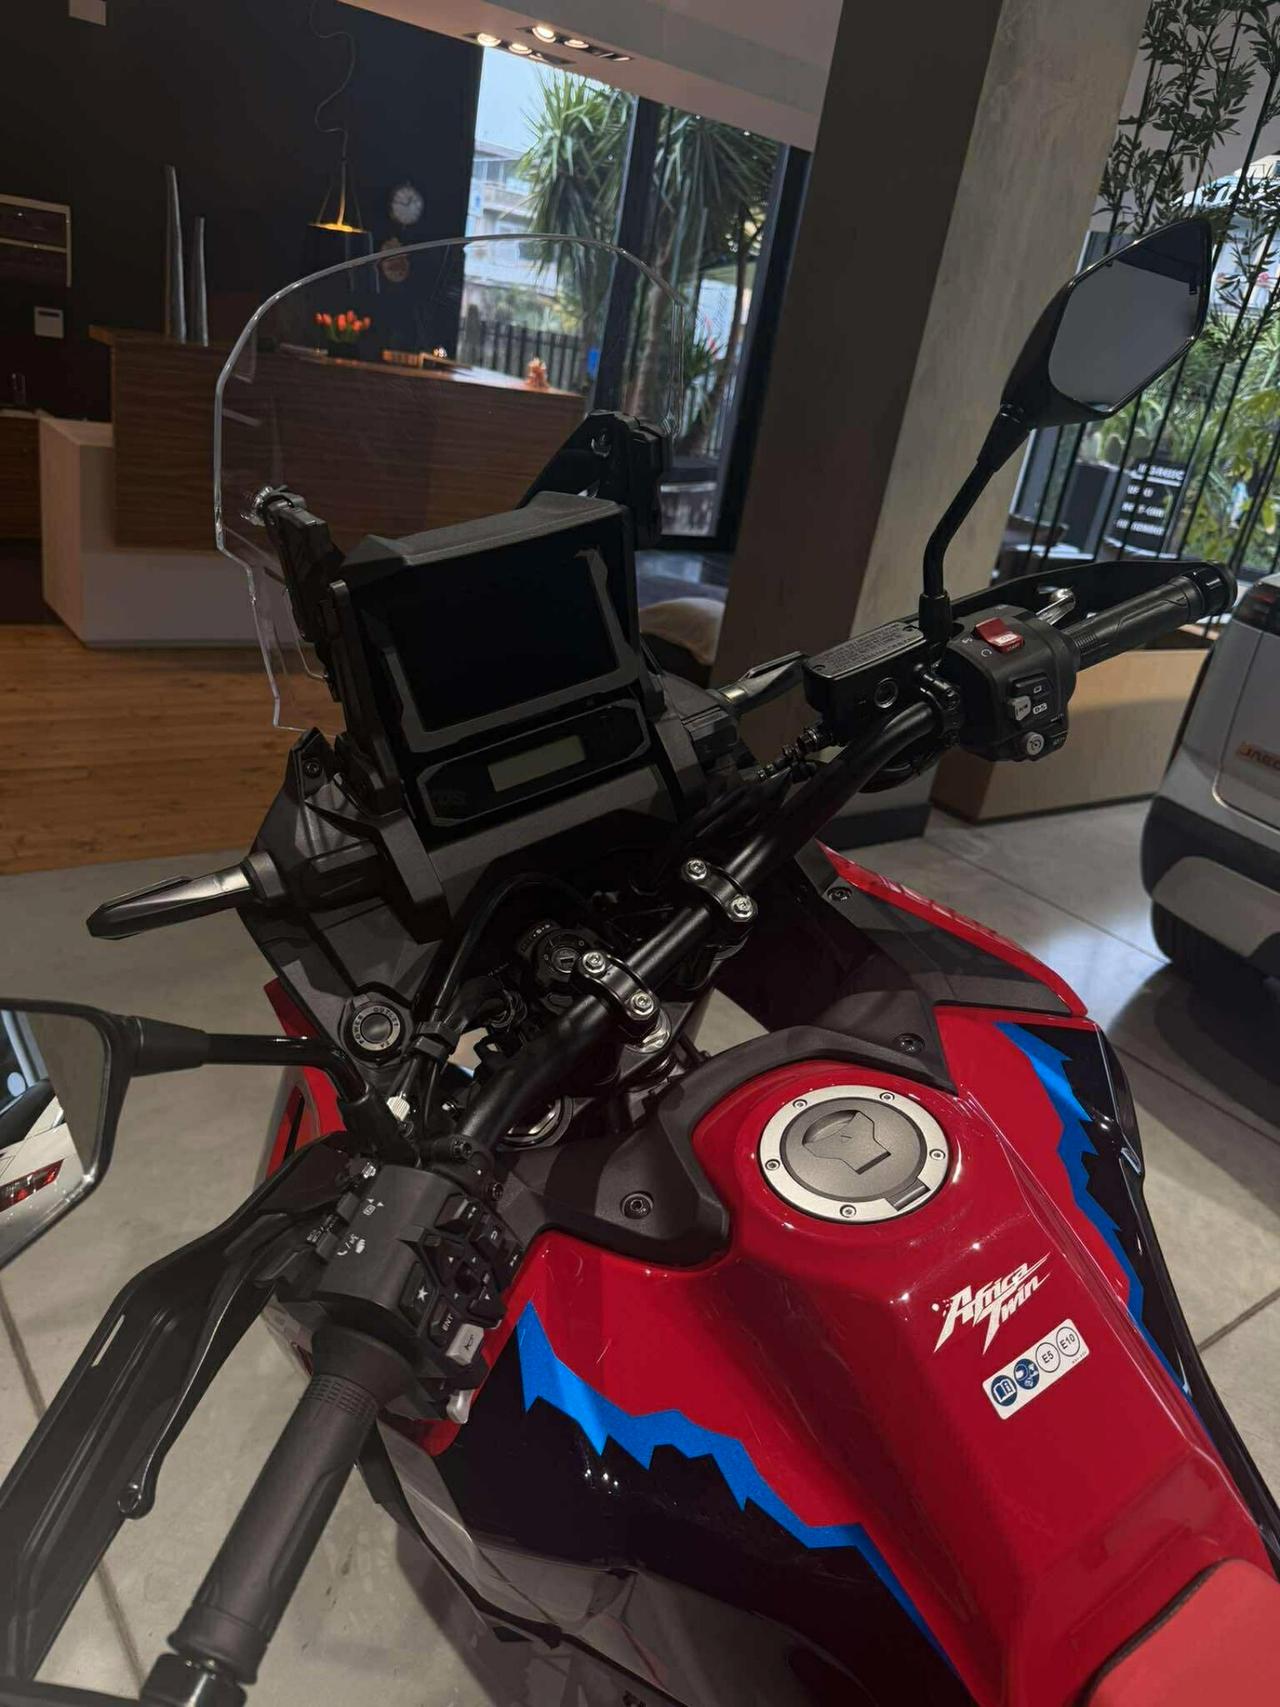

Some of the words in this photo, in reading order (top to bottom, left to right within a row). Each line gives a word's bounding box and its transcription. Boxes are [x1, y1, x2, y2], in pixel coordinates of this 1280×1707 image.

[354, 1015, 364, 1043] POWER
[933, 1251, 1051, 1353] Africa
[983, 1272, 1051, 1355] Twin
[1041, 1349, 1054, 1364] E5
[1059, 1333, 1076, 1350] E10
